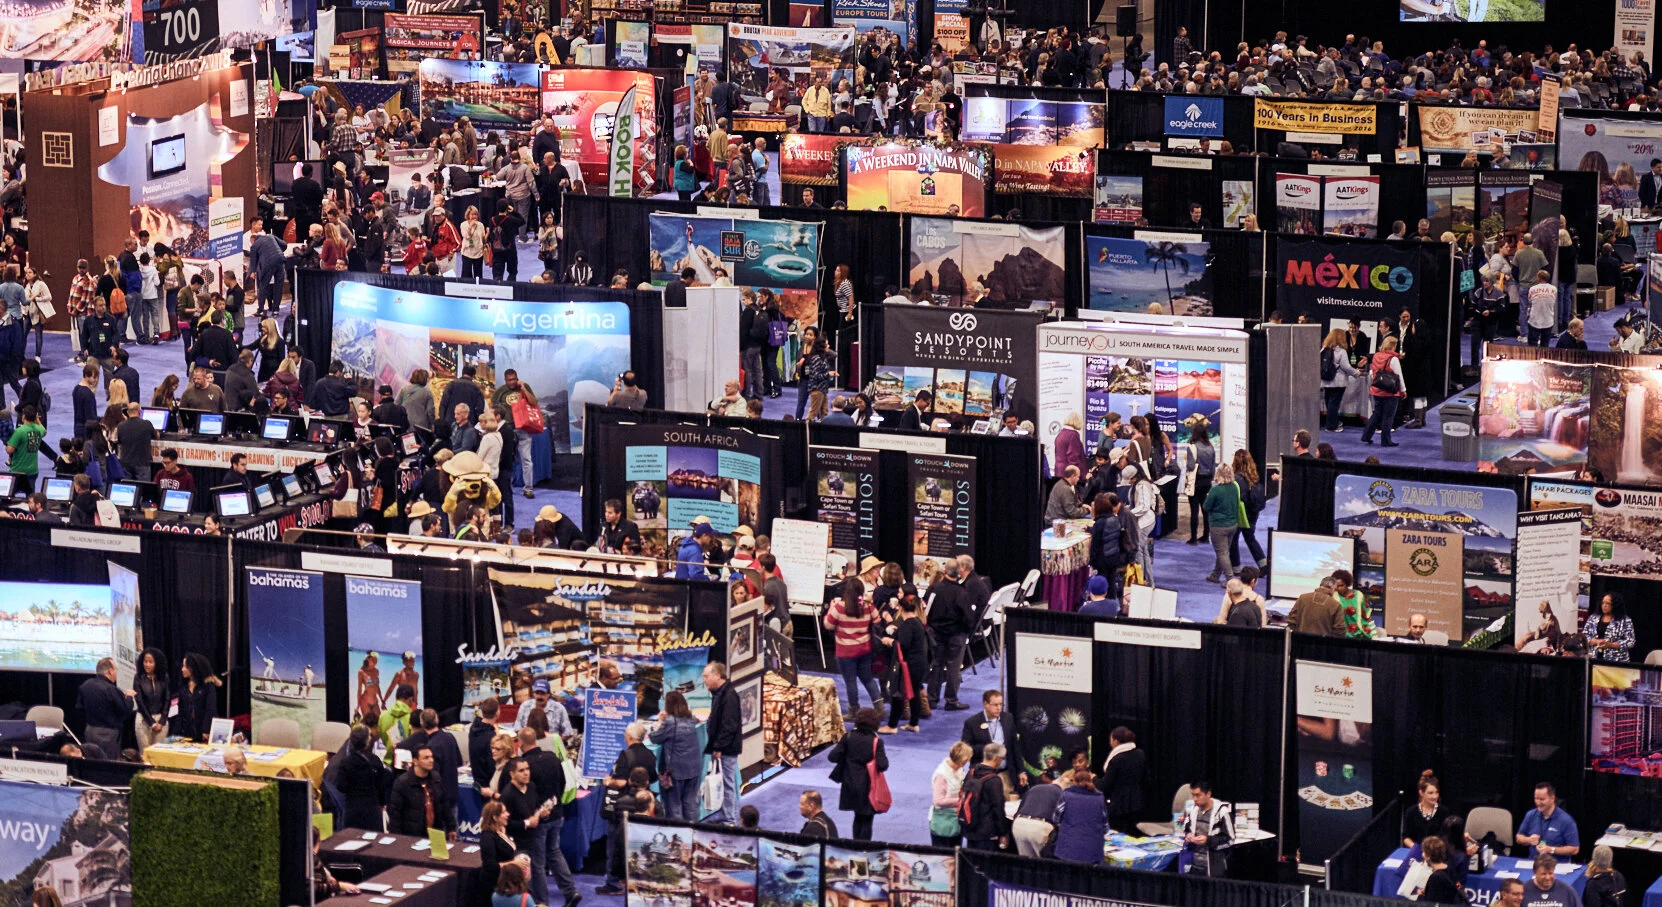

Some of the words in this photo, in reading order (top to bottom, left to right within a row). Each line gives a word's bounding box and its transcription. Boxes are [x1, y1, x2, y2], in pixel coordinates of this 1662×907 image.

[160, 7, 200, 47] 700
[1257, 108, 1274, 118] 100
[1276, 110, 1306, 122] Years
[1309, 112, 1319, 122] in
[1322, 113, 1374, 124] Business
[1496, 120, 1514, 128] plan
[616, 114, 632, 174] BOOK
[1634, 144, 1654, 154] 20%
[862, 152, 917, 171] WEEKEND
[919, 152, 932, 166] IN
[934, 152, 958, 170] NAPA
[958, 156, 982, 180] VALLEY
[1004, 160, 1012, 169] in
[1015, 160, 1043, 170] NAPA
[1046, 161, 1088, 172] VALLEY
[1336, 186, 1368, 194] AATKings
[724, 246, 741, 255] SUR
[1316, 296, 1383, 308] visitmexico.com
[492, 309, 616, 332] Argentina
[914, 332, 1012, 350] SANDYPOINT
[1142, 341, 1171, 350] AMERICA
[914, 345, 1012, 358] RESORTS
[664, 432, 700, 443] SOUTH
[704, 434, 739, 448] AFRICA
[186, 447, 216, 462] DRAWING
[1368, 488, 1396, 499] ZARA
[1400, 486, 1438, 506] ZARA
[1440, 488, 1484, 510] TOURS
[1556, 487, 1592, 496] PACKAGES
[858, 472, 874, 539] SOUTH
[1624, 494, 1656, 506] MAASAI
[916, 503, 930, 512] Cape
[956, 480, 970, 547] SOUTH
[1377, 510, 1472, 523] WWW.ZARATOURS.COM
[1520, 515, 1534, 523] WHY
[1535, 514, 1548, 522] VISIT
[1402, 534, 1422, 544] ZARA
[1423, 536, 1447, 546] TOURS
[1409, 558, 1440, 568] ZARA
[250, 572, 310, 590] bahamas
[552, 577, 612, 596] Sandals
[348, 581, 408, 599] bahamas
[654, 630, 718, 653] Sandals
[454, 642, 519, 664] Sandals
[1047, 659, 1074, 668] Martin
[1314, 685, 1325, 693] St
[1328, 687, 1354, 696] Martin
